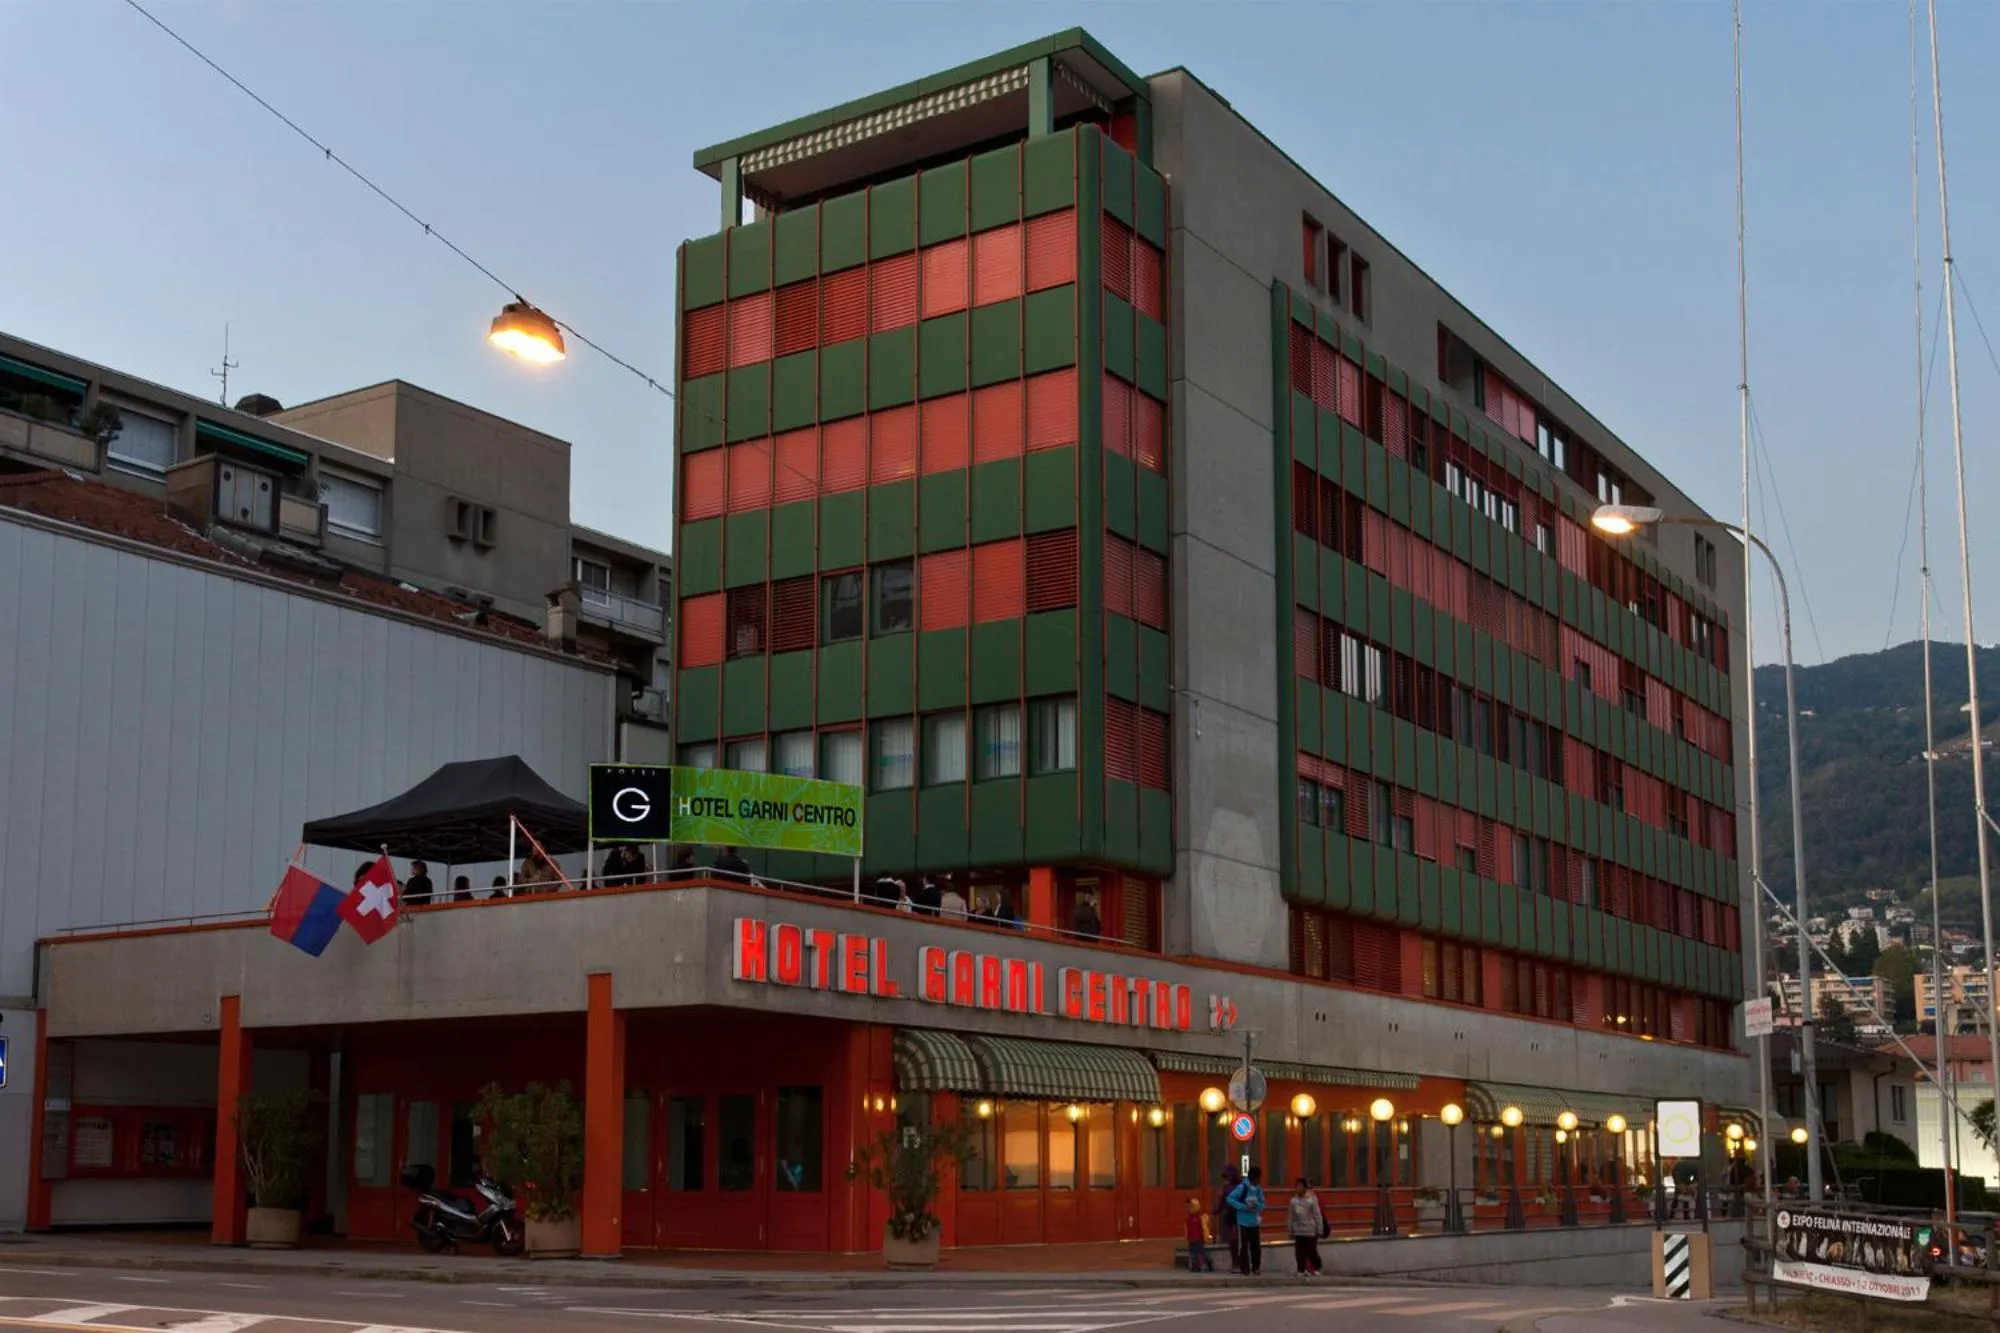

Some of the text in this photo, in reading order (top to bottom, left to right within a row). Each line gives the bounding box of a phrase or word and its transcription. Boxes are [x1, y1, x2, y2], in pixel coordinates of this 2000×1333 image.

[612, 787, 651, 823] G
[679, 796, 856, 827] HOTEL GARNI CENTRO
[733, 916, 1191, 1031] HOTEL GARNI CENTRO
[1792, 1215, 1911, 1239] EXPO FELINA INTERNAZIONALE
